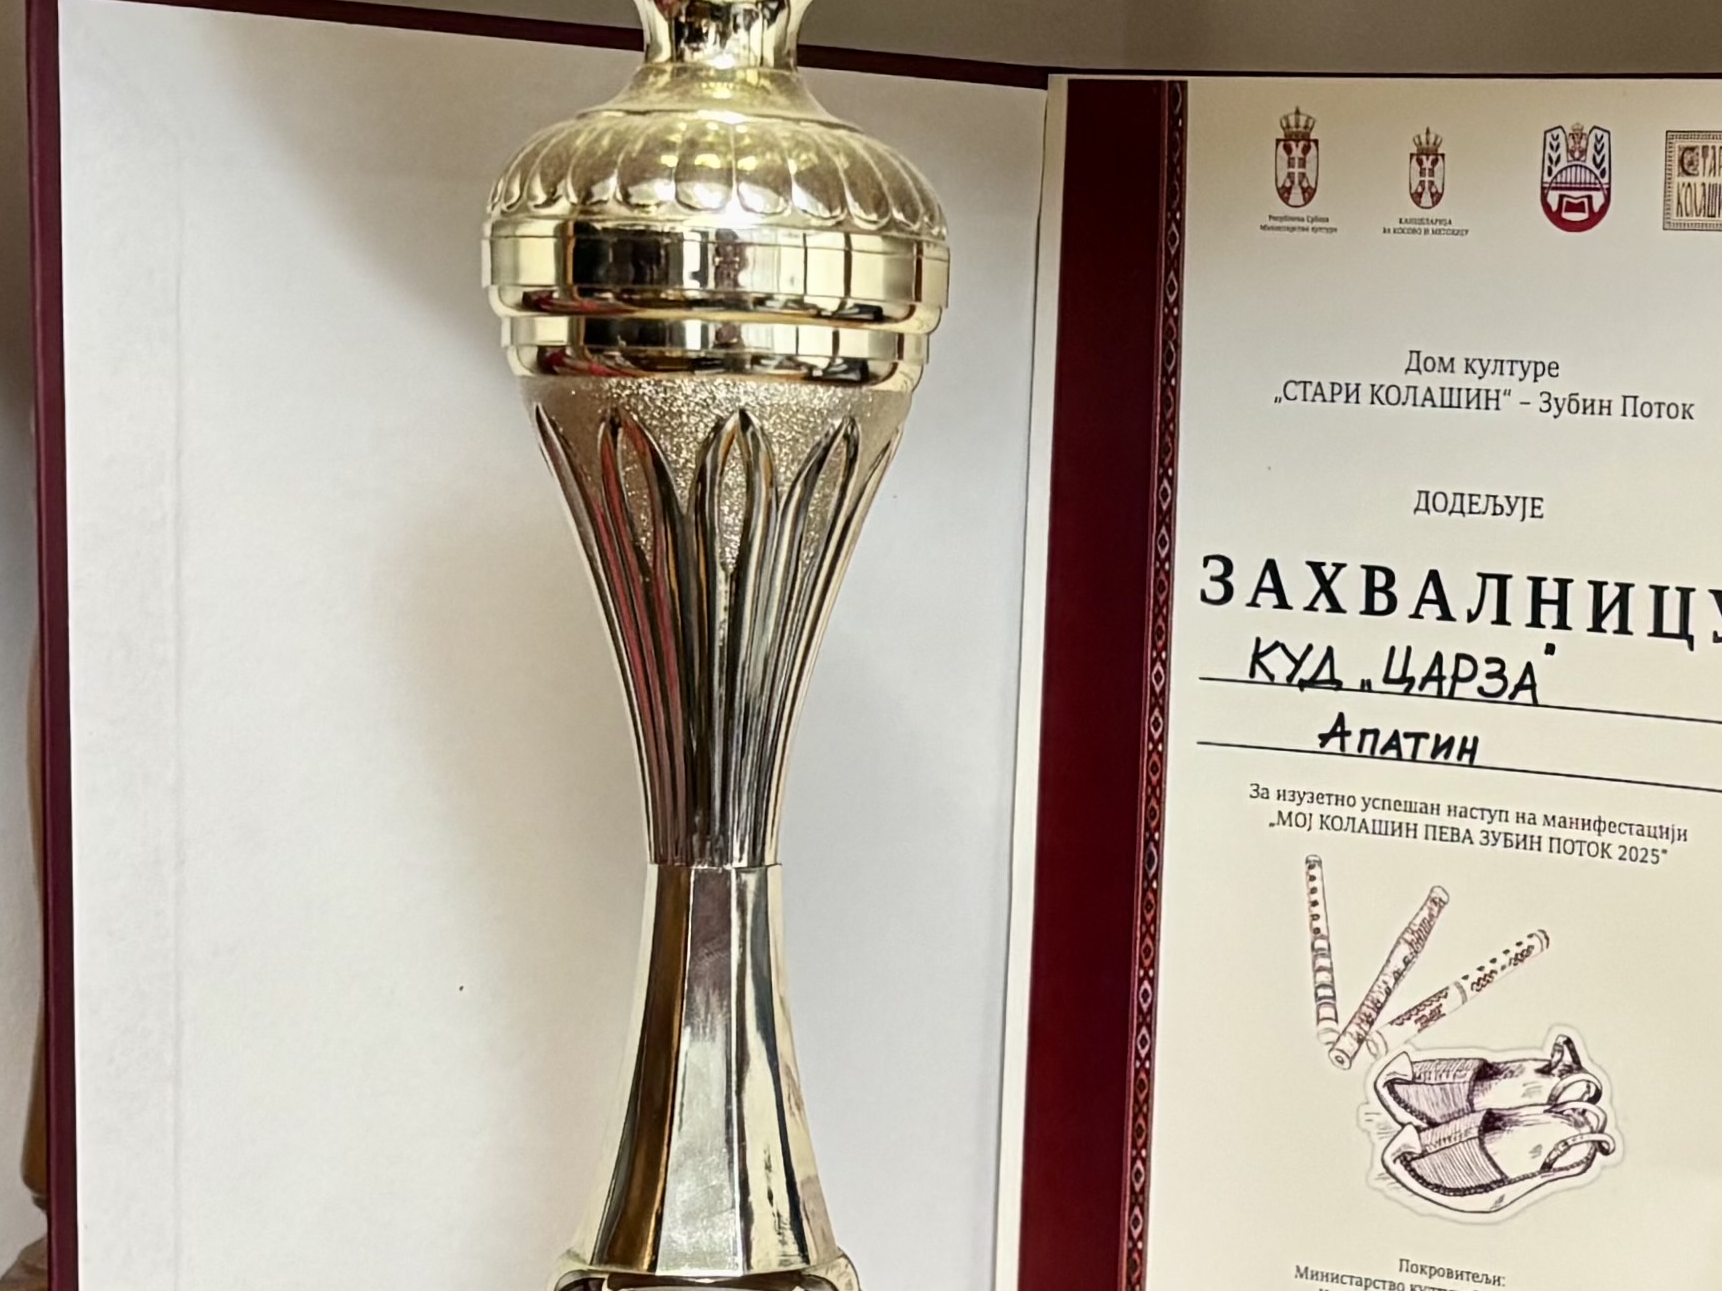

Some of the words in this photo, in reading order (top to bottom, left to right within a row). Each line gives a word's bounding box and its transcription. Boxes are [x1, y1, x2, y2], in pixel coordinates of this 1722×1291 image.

[1405, 350, 1455, 377] Дом
[1465, 355, 1560, 382] културе
[1274, 380, 1360, 406] „СТАРИ
[1369, 384, 1511, 411] КОЛАШИН“
[1538, 390, 1613, 420] Зубин
[1622, 394, 1695, 421] Поток
[1413, 490, 1544, 521] ДОДЕЉУЈЕ
[1249, 637, 1342, 692] КУД
[1249, 783, 1270, 799] За
[1276, 787, 1357, 809] изузетно
[1361, 795, 1440, 816] успешан
[1447, 803, 1509, 824] наступ
[1515, 810, 1536, 826] на
[1543, 813, 1688, 844] манифестацији
[1269, 811, 1314, 832] „МОЈ
[1319, 814, 1418, 839] КОЛАШИН
[1424, 824, 1474, 845] ПЕВА
[1479, 831, 1542, 852] ЗУБИН
[1548, 838, 1612, 860] ПОТОК
[1294, 1265, 1405, 1291] Министарство
[1399, 1259, 1506, 1286] Покровитељи:
